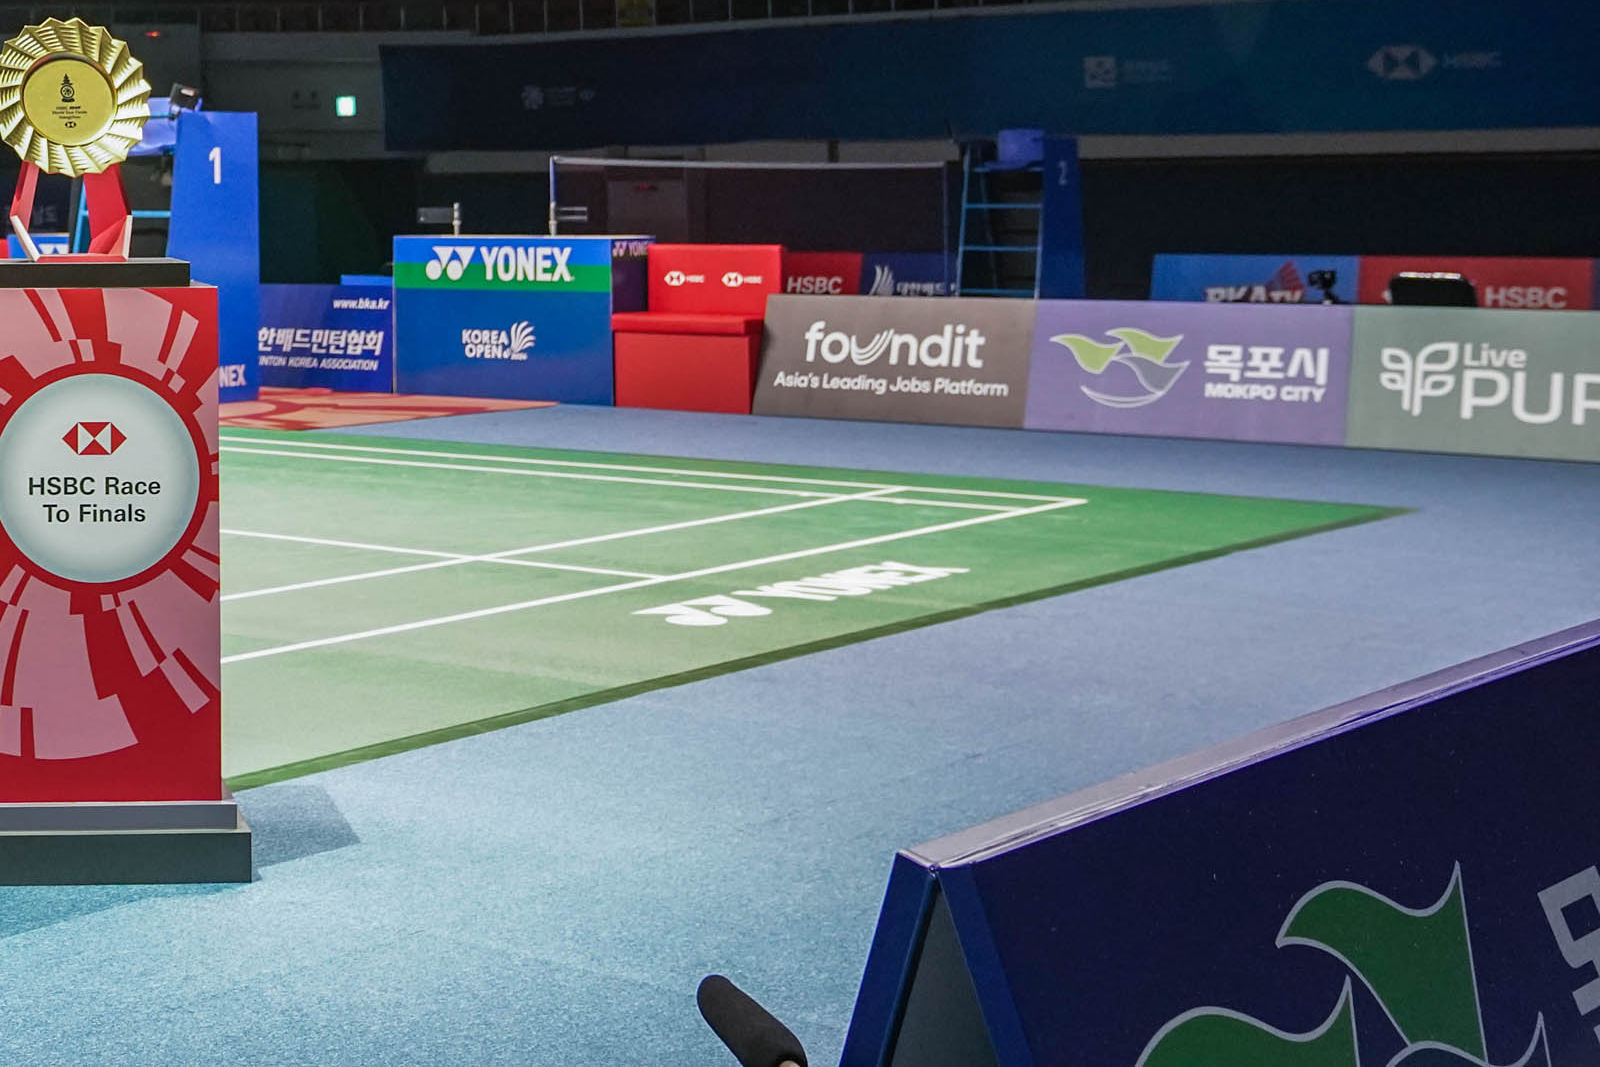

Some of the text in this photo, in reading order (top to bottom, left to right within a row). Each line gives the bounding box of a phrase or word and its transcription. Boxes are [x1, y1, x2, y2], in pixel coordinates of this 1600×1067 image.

[209, 147, 222, 184] 1
[1058, 160, 1068, 186] 2
[480, 246, 573, 282] YONEX
[786, 276, 844, 295] HSBC
[333, 297, 390, 311] www.bka.kr
[1484, 286, 1568, 309] HSBC
[258, 327, 384, 356] 한배드민턴협회
[462, 329, 509, 345] KOREA
[805, 321, 986, 368] foundit
[465, 344, 503, 359] OPEN
[1463, 344, 1527, 368] Live
[288, 356, 318, 368] KOREA
[320, 358, 379, 371] ASSOCIATION
[1204, 344, 1329, 385] 목포시
[774, 371, 1009, 397] Asia's Leading Jobs Platform
[1204, 382, 1326, 403] MOKPO CITY
[29, 477, 161, 495] HSBC Race
[43, 503, 146, 522] To Finals
[731, 561, 968, 601] YONEX
